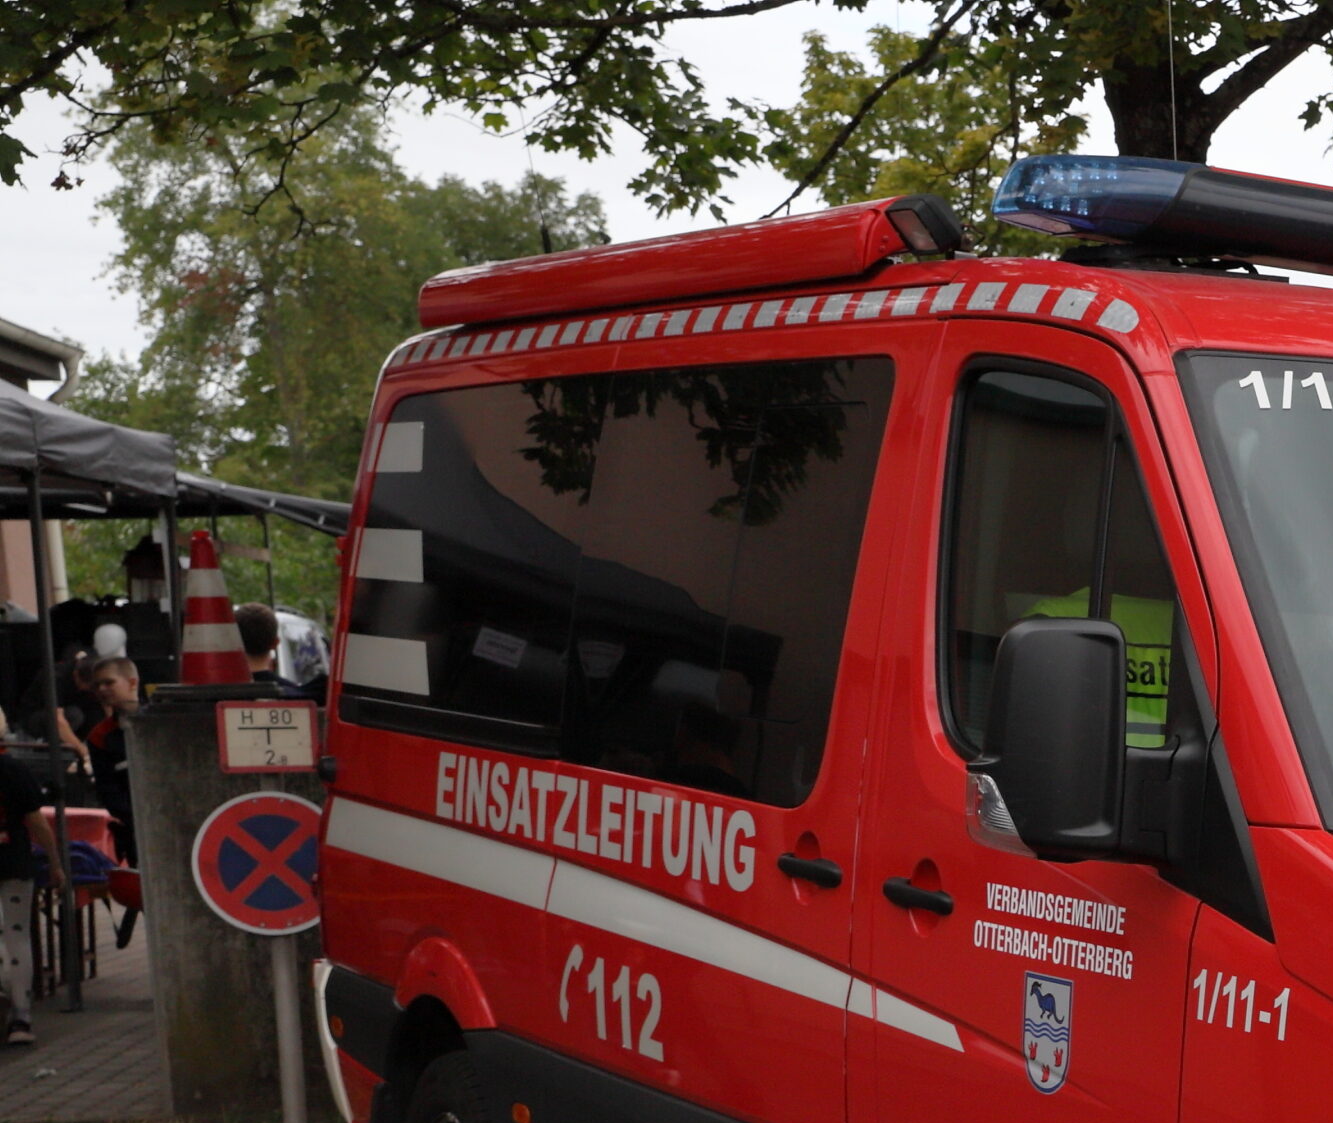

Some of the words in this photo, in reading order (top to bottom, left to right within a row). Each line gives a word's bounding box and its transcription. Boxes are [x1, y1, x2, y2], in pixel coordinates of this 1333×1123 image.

[241, 709, 254, 724] H
[269, 709, 292, 725] 80
[435, 751, 757, 892] EINSATZLEITUNG
[986, 882, 1126, 935] VERBANDSGEMEINDE
[973, 919, 1134, 980] OTTERBACH-OTTERBERG
[587, 957, 665, 1063] 112
[1193, 968, 1290, 1041] 1/11-1
